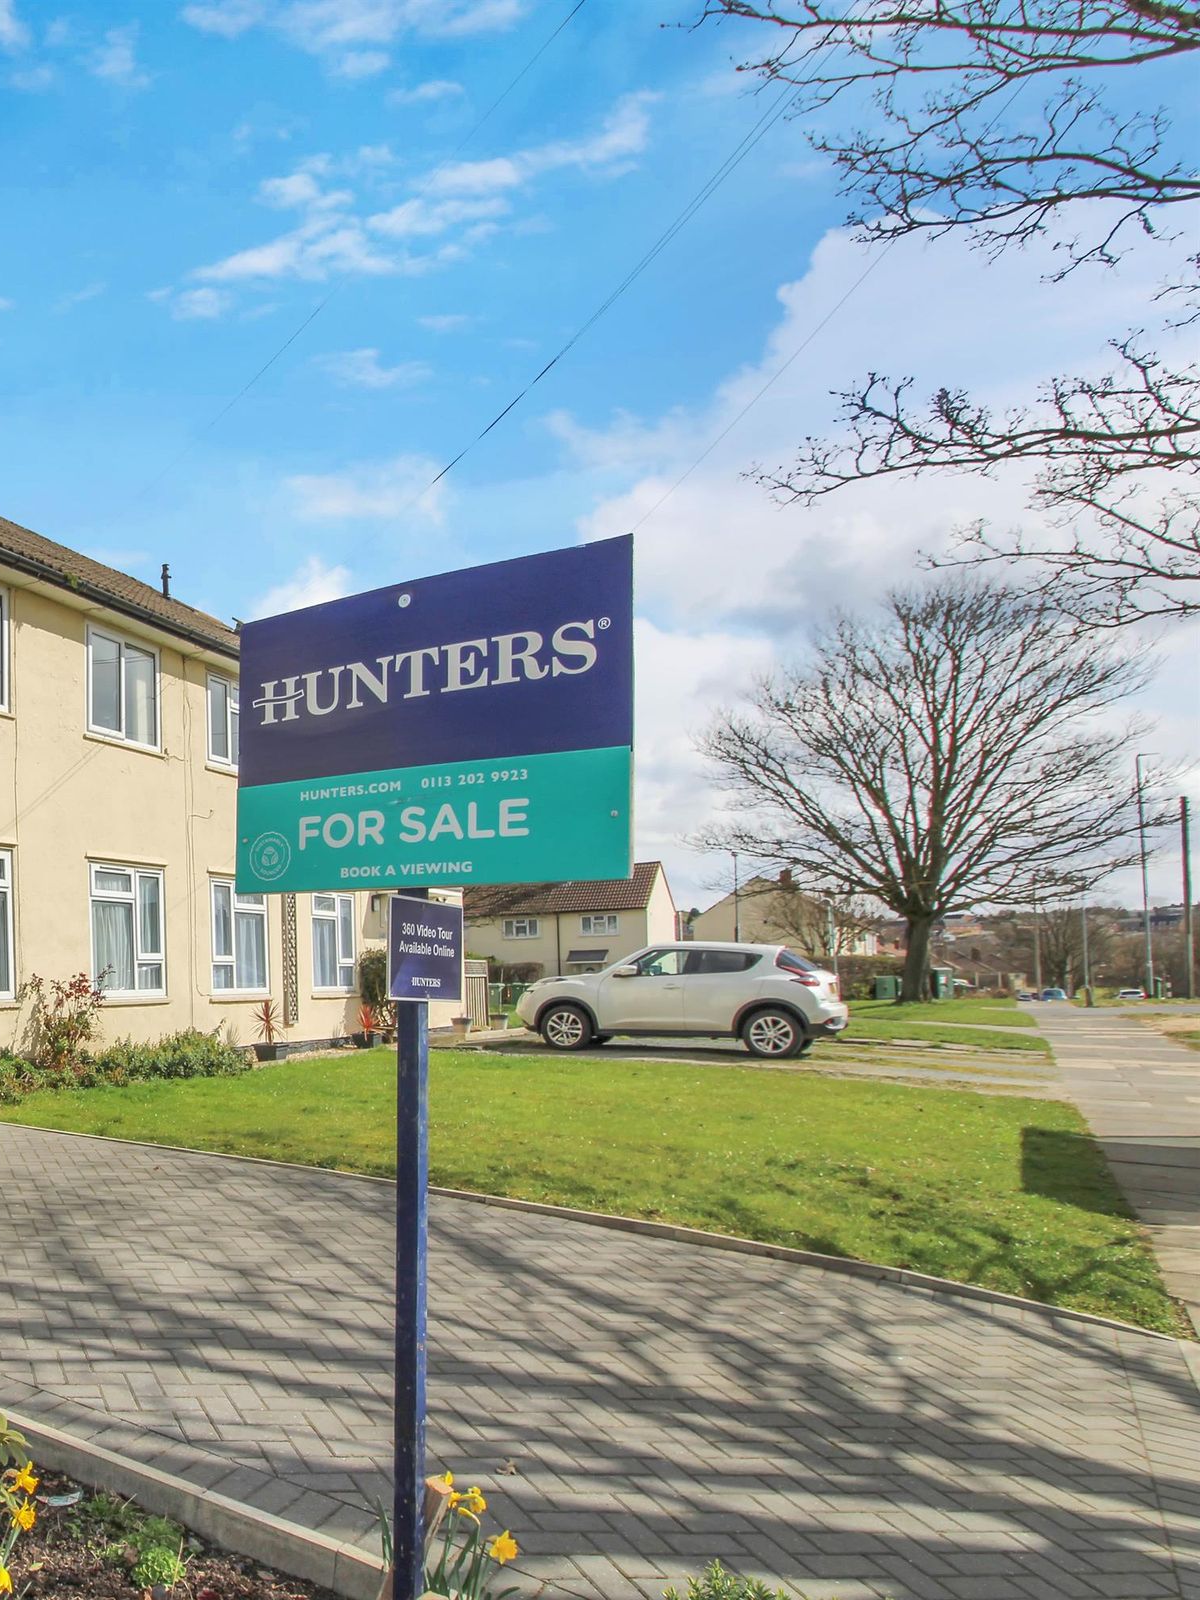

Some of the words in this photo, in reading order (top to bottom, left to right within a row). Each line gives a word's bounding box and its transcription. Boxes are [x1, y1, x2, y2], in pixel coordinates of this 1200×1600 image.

[421, 776, 452, 789] 0113
[458, 773, 486, 786] 202
[491, 769, 529, 783] 9923
[299, 780, 402, 801] HUNTERS.COM
[298, 810, 386, 851] FOR
[399, 798, 530, 844] SALE
[340, 865, 382, 879] BOOK
[385, 864, 397, 876] A
[400, 861, 473, 876] VIEWING
[401, 922, 415, 936] 360
[416, 924, 436, 939] Video
[437, 927, 453, 940] Tour
[399, 940, 432, 956] Available
[432, 944, 455, 958] Online
[411, 976, 441, 988] HUNTERS
